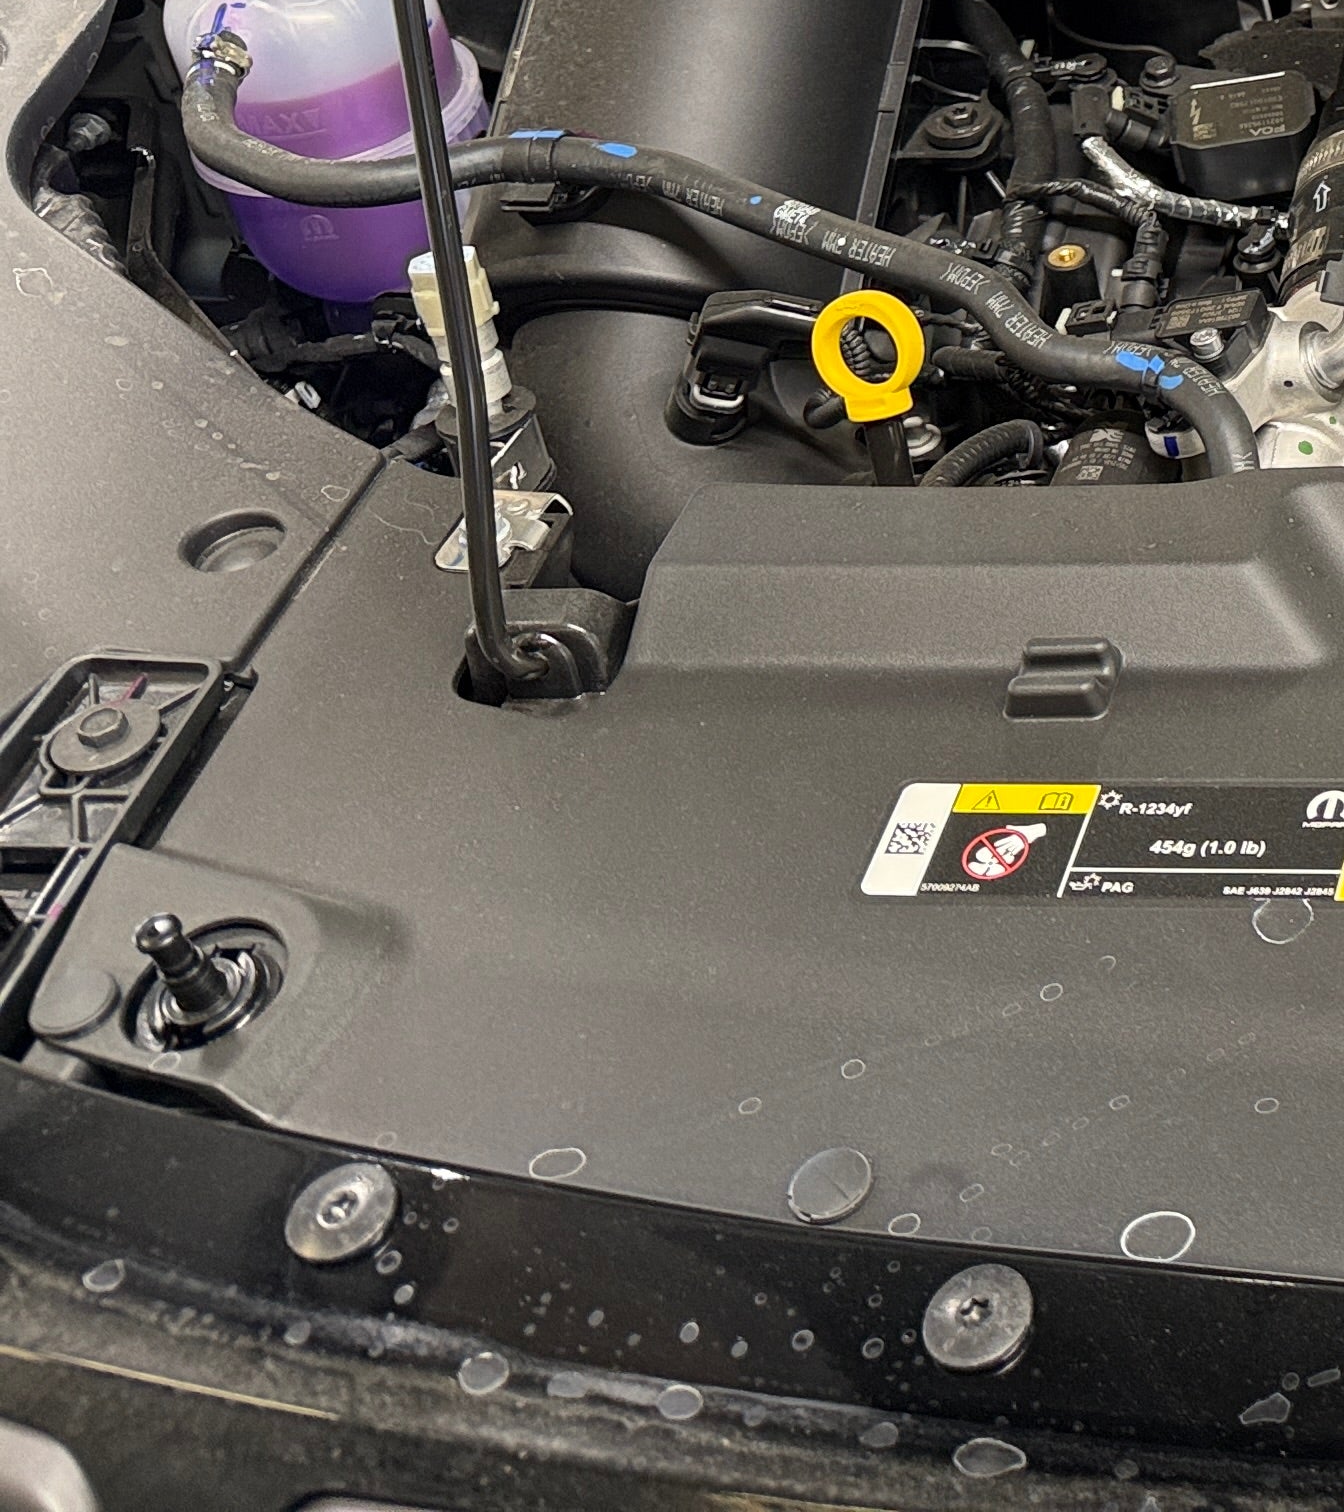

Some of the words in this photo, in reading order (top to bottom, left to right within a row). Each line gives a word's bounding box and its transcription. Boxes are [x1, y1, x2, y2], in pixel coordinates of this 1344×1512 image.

[848, 238, 897, 267] HEATER
[985, 291, 1015, 319] 7MM
[1004, 311, 1053, 348] HEATER
[1119, 802, 1192, 818] R-1234yf
[1149, 840, 1197, 857] 454g
[1200, 839, 1236, 857] (1.0
[1240, 839, 1266, 857] lb)
[1101, 881, 1134, 894] PAG
[1222, 886, 1246, 895] SAE
